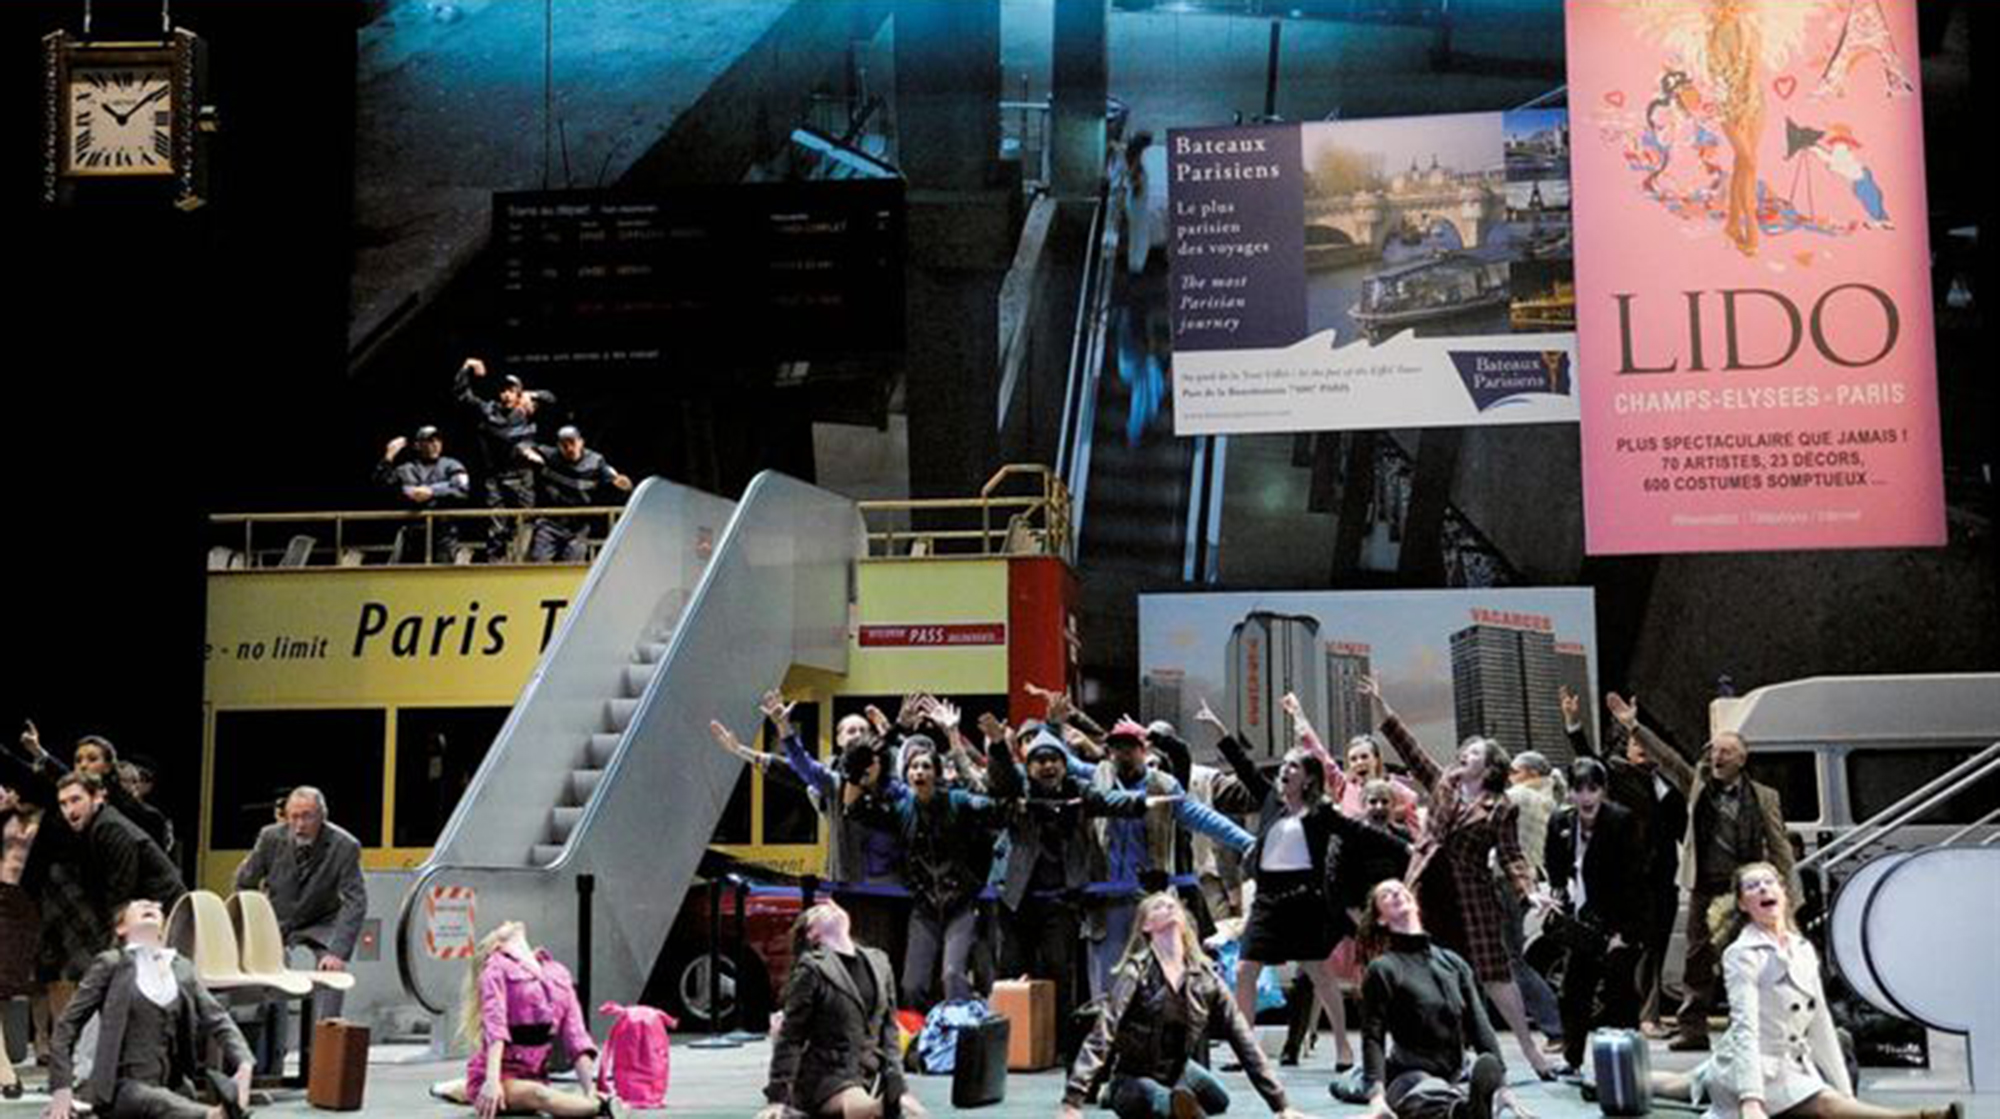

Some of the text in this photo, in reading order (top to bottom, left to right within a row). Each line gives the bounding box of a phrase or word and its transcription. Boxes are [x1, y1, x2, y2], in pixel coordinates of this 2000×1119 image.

[1176, 136, 1266, 154] Bateaux
[1177, 163, 1280, 182] Parisiens
[1177, 200, 1234, 218] Le plus
[1177, 219, 1241, 239] parisien
[1177, 242, 1269, 258] des voyages
[1181, 275, 1248, 289] The most
[1180, 295, 1246, 310] Parisian
[1177, 317, 1240, 335] journey
[1611, 282, 1901, 376] LIDO
[1475, 357, 1541, 372] Bateaux
[1473, 373, 1545, 389] Parisiens
[1614, 386, 1820, 415] CHAMPS-ELYSEES
[1836, 383, 1907, 407] PARIS
[1616, 434, 1659, 453] PLUS
[1662, 431, 1794, 452] SPECTACULAIRE
[1798, 430, 1830, 449] QUE
[1837, 428, 1898, 446] JAMAIS
[1661, 456, 1679, 471] 70
[1683, 454, 1767, 472] ARTISTES,
[1769, 453, 1790, 469] 23
[1674, 474, 1763, 492] COSTUMES
[1766, 472, 1869, 490] SOMPTUEUX
[236, 641, 265, 660] no
[271, 635, 329, 660] limit
[352, 601, 508, 659] Paris
[908, 627, 945, 644] PASS
